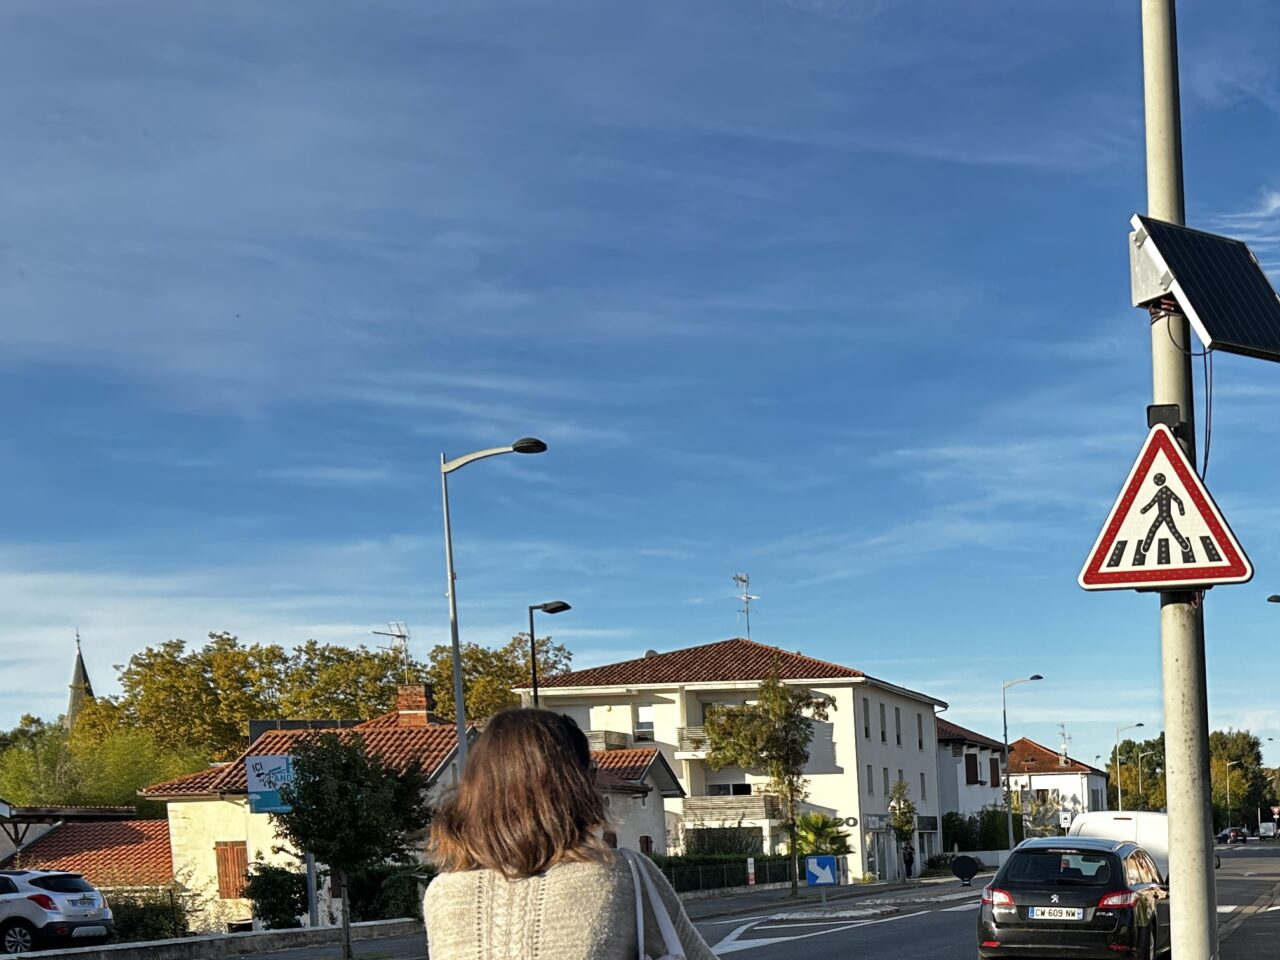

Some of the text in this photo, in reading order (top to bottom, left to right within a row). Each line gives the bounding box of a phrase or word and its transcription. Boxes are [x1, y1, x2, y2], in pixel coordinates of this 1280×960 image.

[252, 761, 264, 773] ICI
[1035, 909, 1046, 917] CW
[1048, 909, 1063, 917] 609
